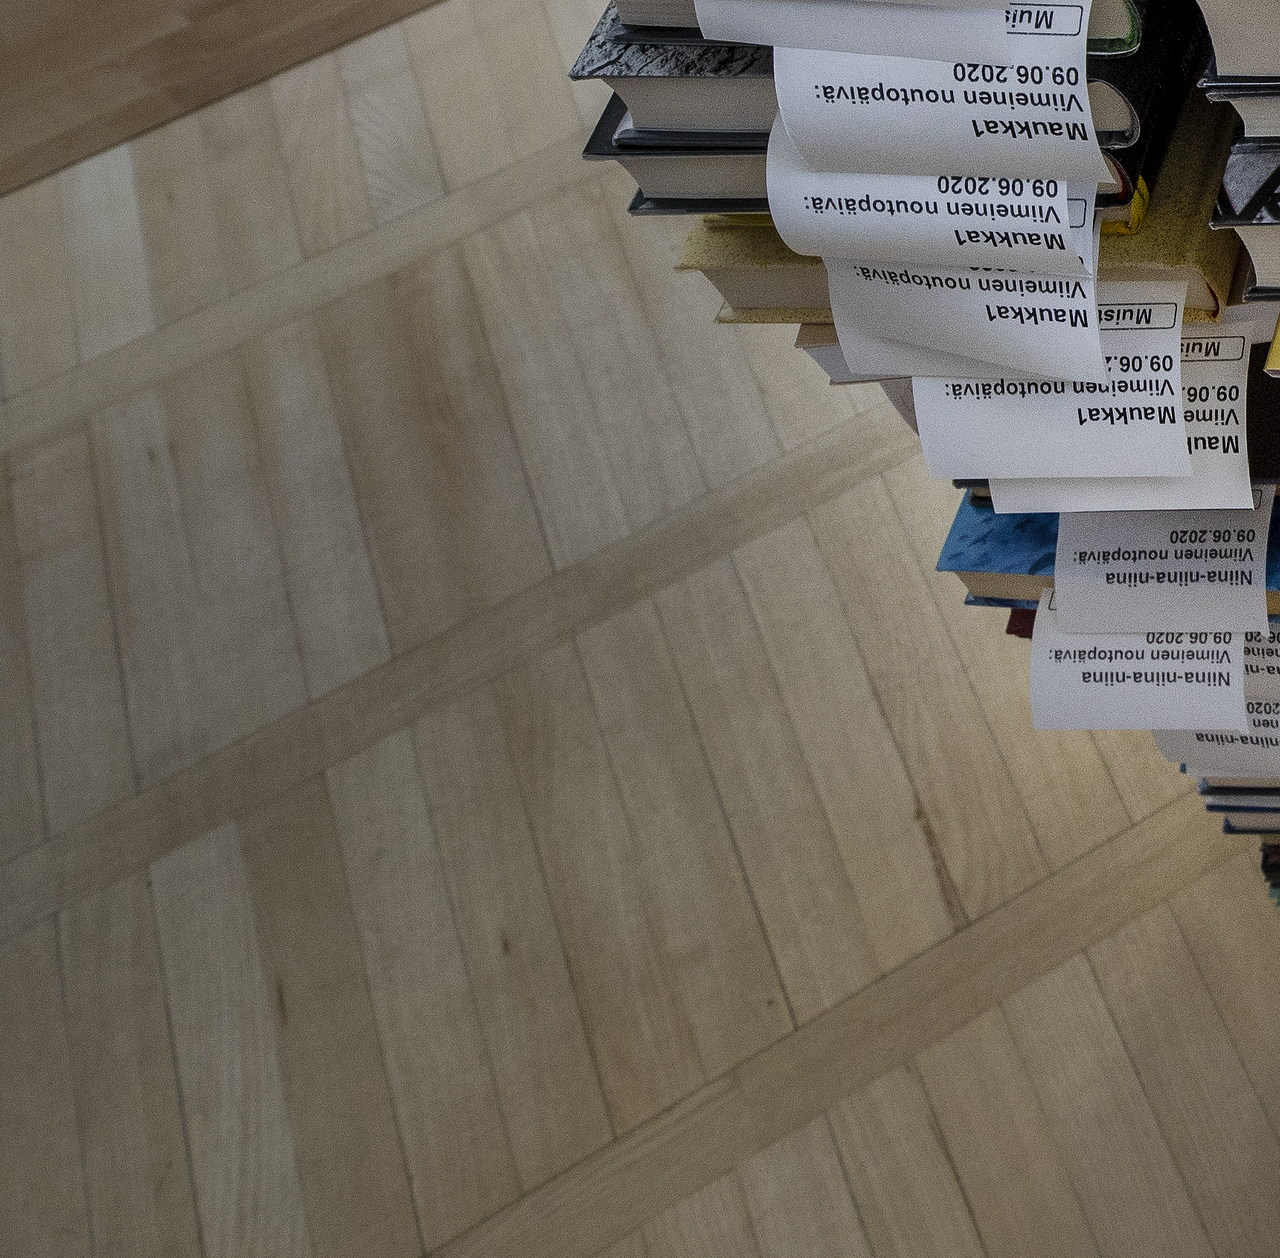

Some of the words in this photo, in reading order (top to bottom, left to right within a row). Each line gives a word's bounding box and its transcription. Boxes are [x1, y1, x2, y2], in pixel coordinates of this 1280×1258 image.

[937, 176, 1058, 197] 09.06.2020
[804, 195, 938, 218] noutopäivä:
[946, 202, 1061, 223] Viimeinen
[954, 230, 1065, 250] Maukka1
[1170, 529, 1256, 543] 09.06.2020
[1176, 548, 1254, 562] Viimeinen
[1106, 570, 1253, 586] Niina-niina-niina
